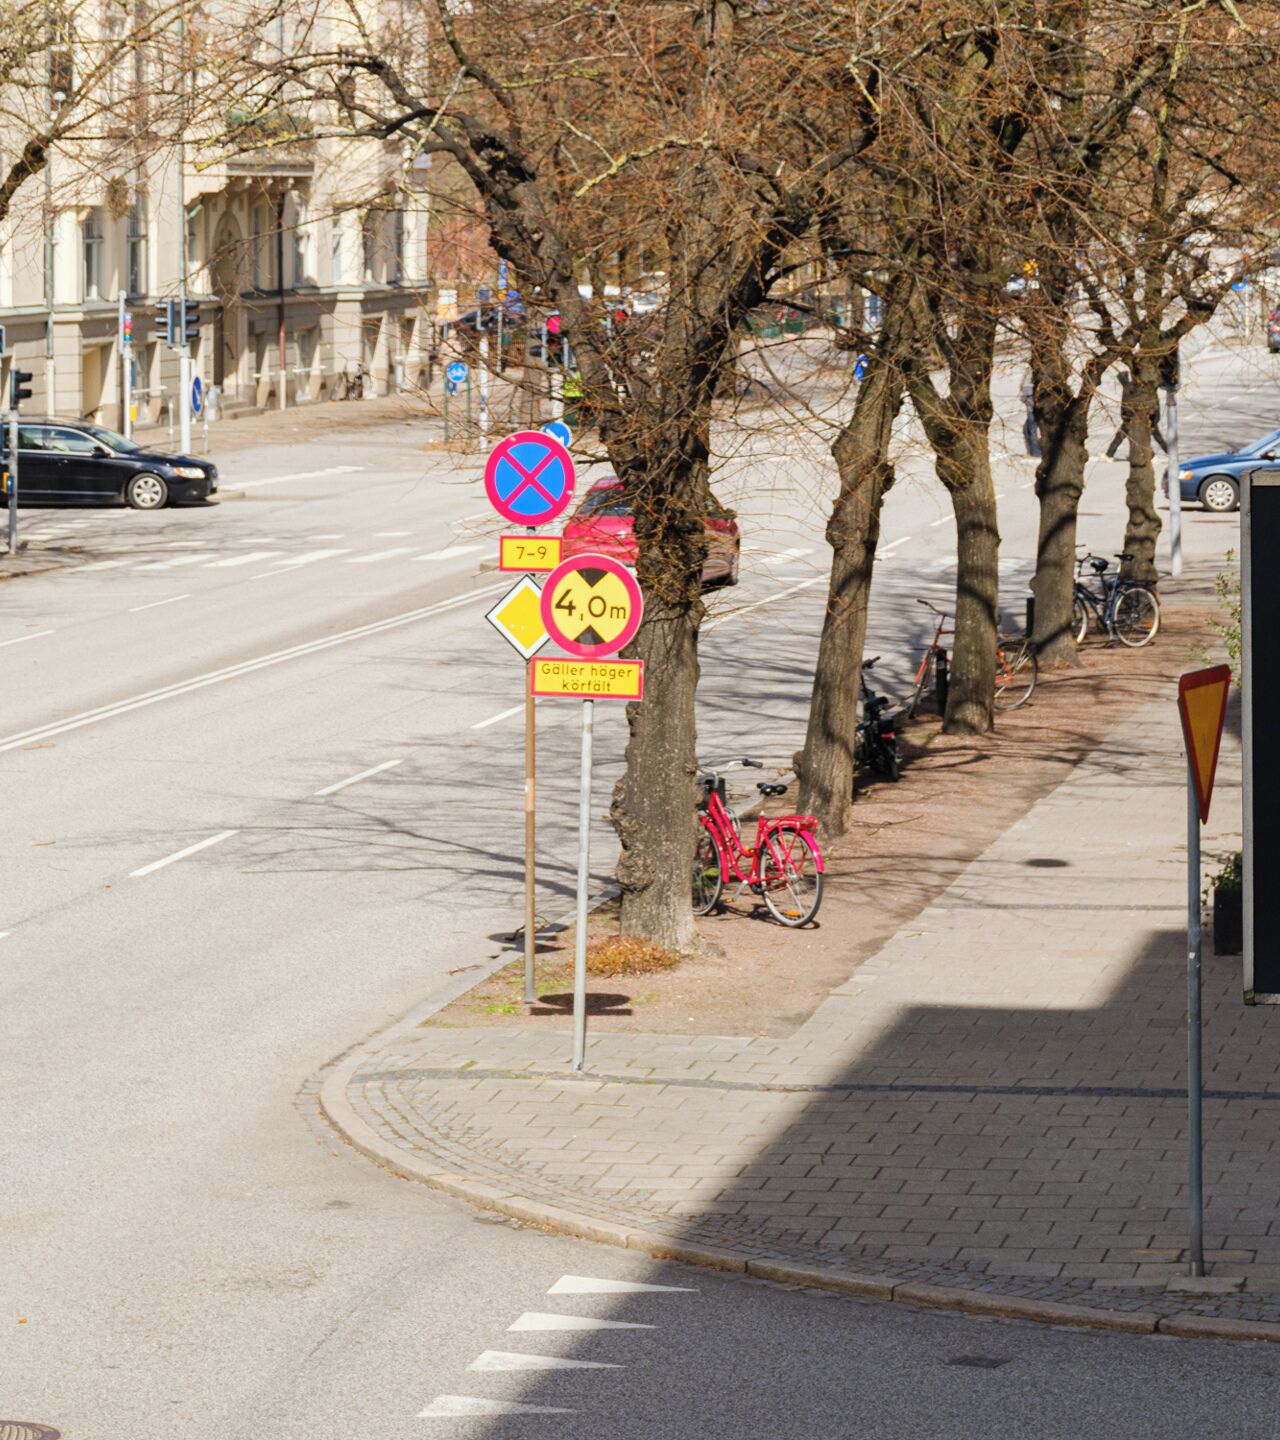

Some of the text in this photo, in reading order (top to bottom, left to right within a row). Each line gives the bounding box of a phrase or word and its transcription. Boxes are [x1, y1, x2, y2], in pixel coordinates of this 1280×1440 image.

[515, 546, 547, 560] 7-9
[541, 663, 632, 680] Gäller höger
[562, 679, 611, 692] körfält
